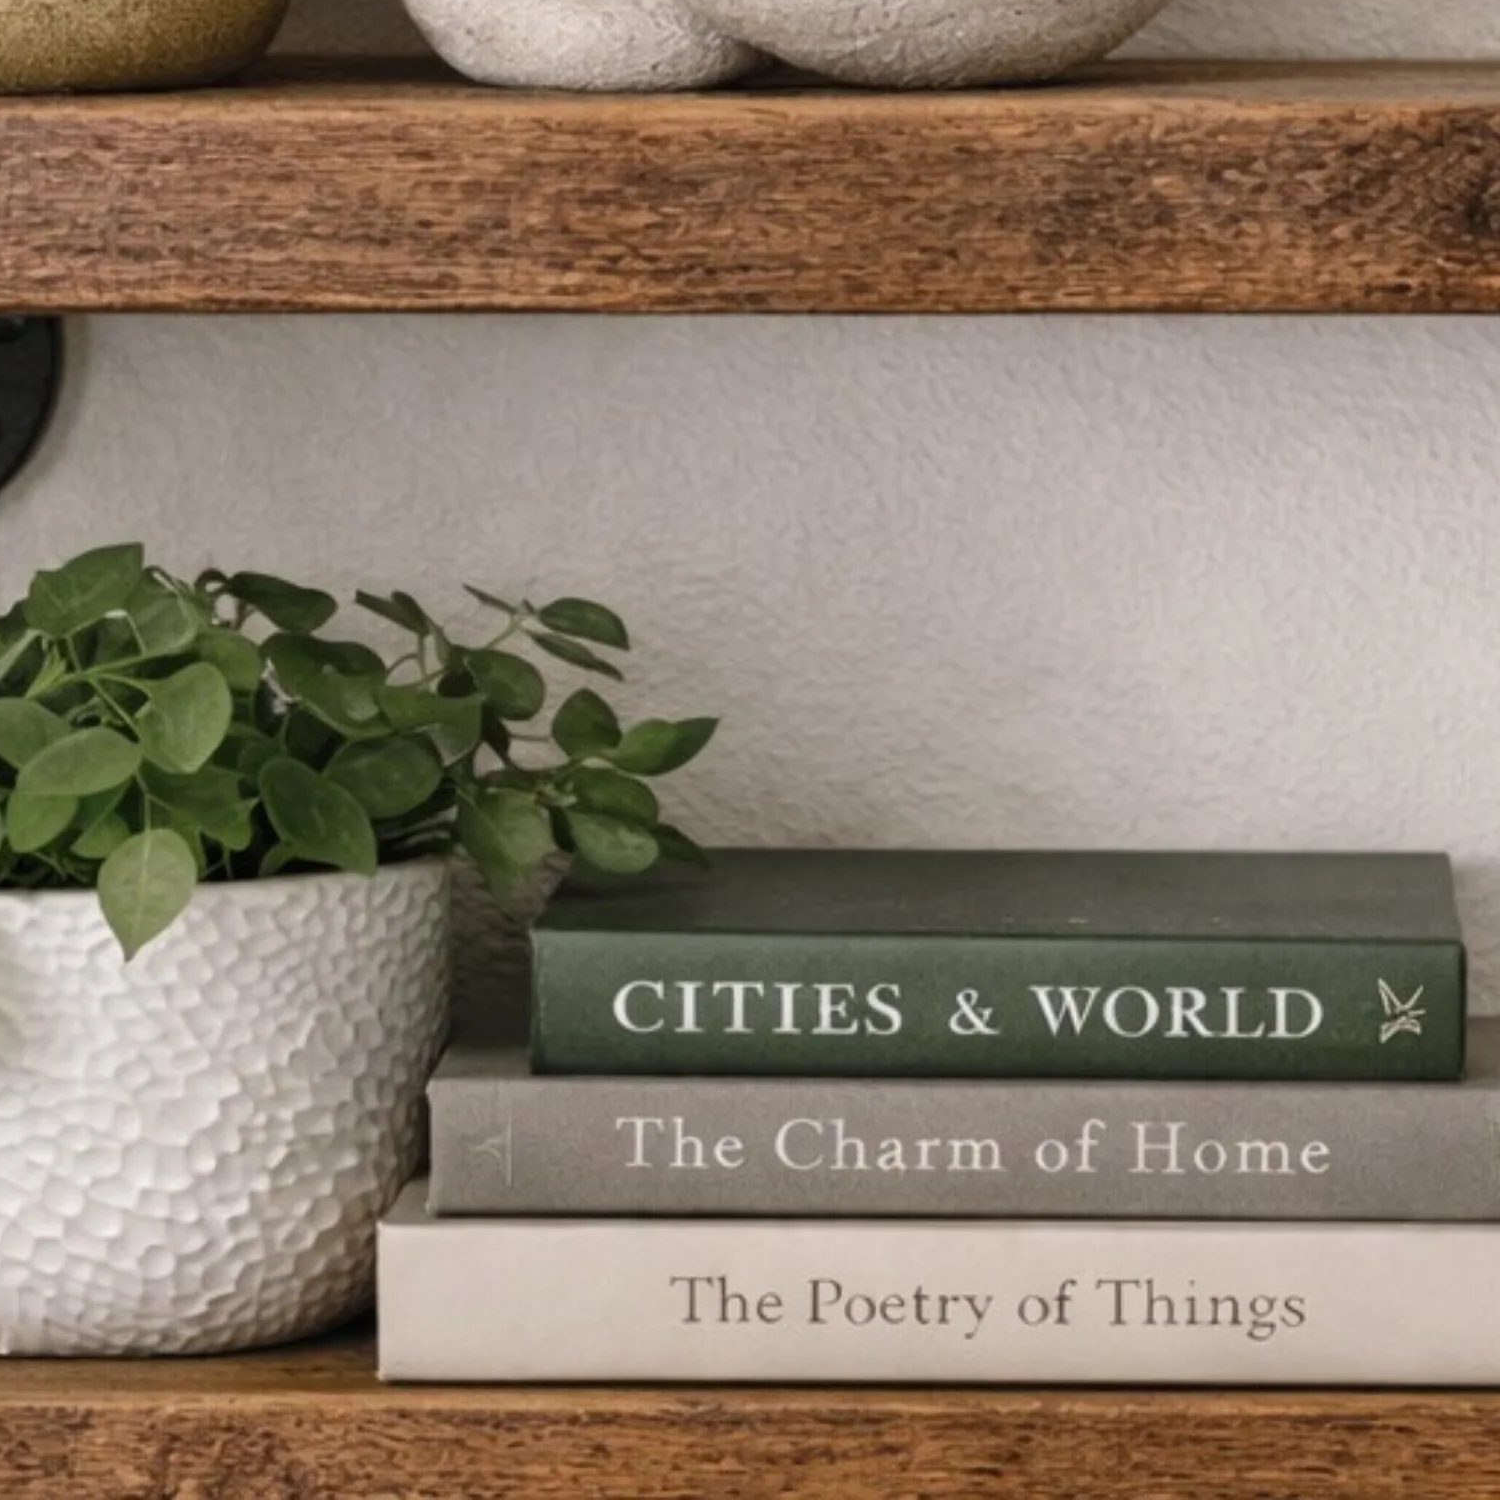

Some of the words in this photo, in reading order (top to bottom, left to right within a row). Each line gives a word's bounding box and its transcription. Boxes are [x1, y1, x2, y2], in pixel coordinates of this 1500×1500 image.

[612, 980, 904, 1036] CITIES
[948, 988, 999, 1036] &
[1029, 985, 1325, 1040] WORLD
[615, 1115, 744, 1169] The
[774, 1117, 1002, 1171] Charm
[1034, 1118, 1107, 1173] of
[1130, 1121, 1331, 1174] Home
[669, 1274, 784, 1325] The
[807, 1278, 993, 1340] Poetry
[1017, 1277, 1078, 1327] of
[1096, 1278, 1306, 1343] Things
